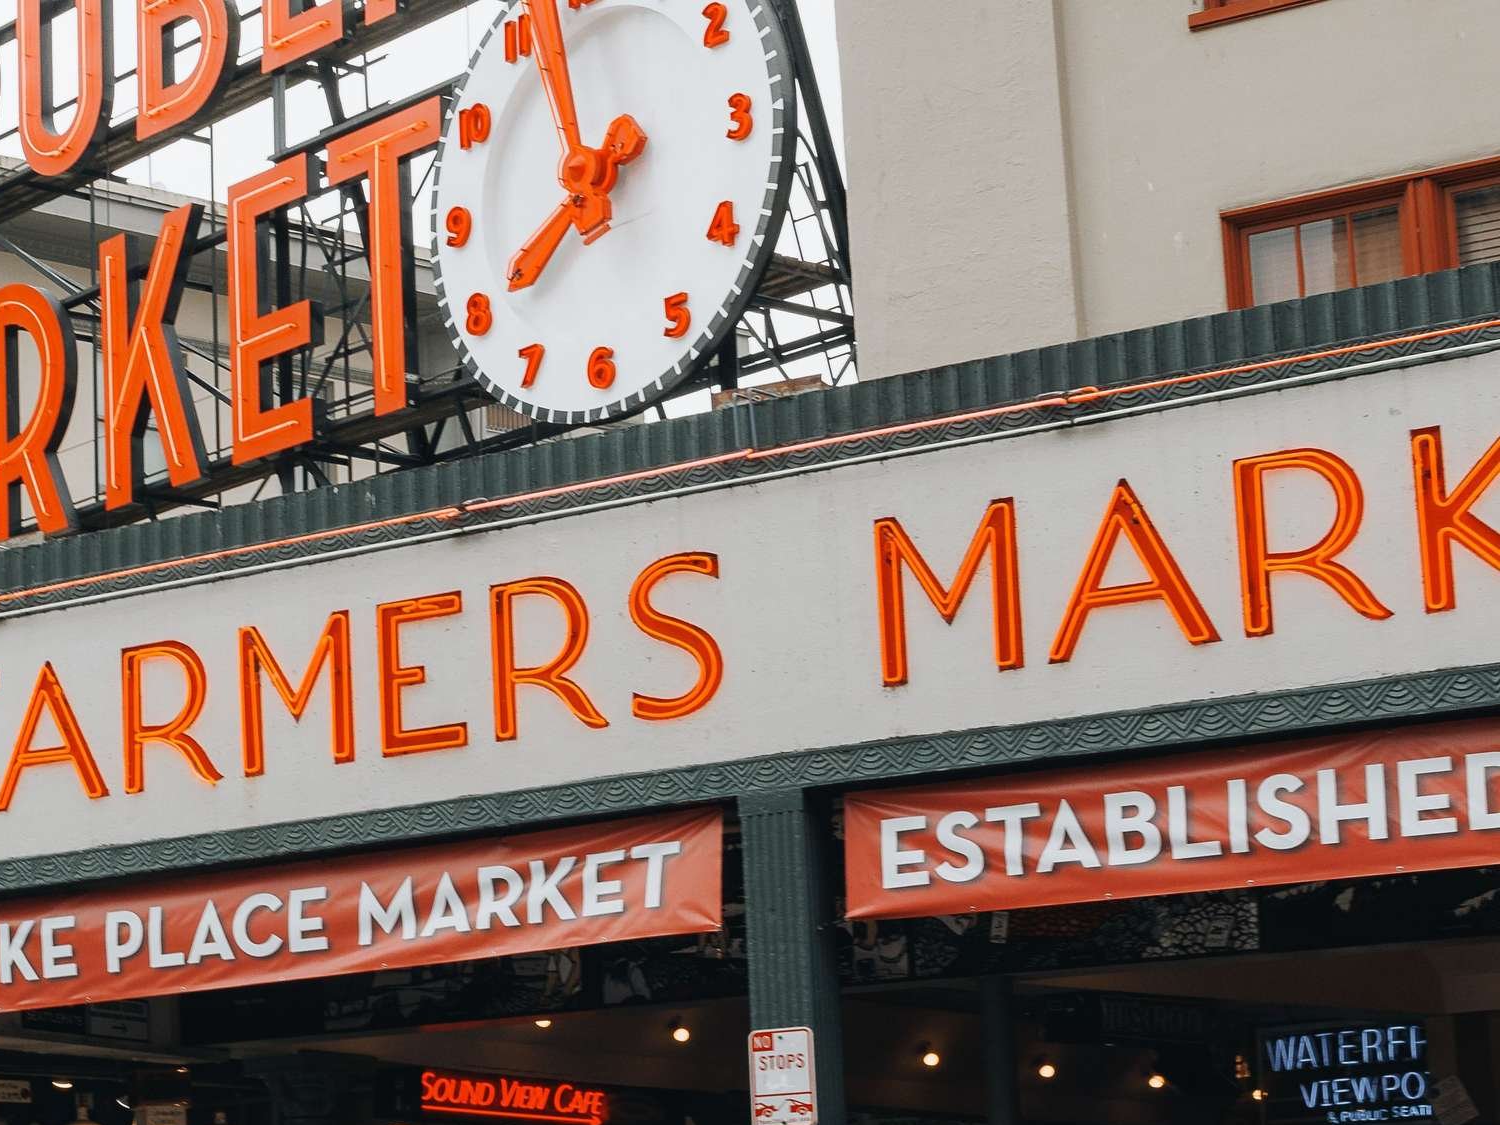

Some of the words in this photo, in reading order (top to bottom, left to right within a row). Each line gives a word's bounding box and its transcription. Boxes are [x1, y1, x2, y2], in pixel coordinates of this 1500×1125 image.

[702, 2, 729, 48] 2
[459, 102, 492, 150] 10
[726, 93, 753, 140] 3
[446, 206, 471, 248] 9
[706, 201, 739, 247] 4
[466, 292, 492, 336] 8
[663, 291, 691, 338] 5
[518, 343, 545, 388] 7
[587, 346, 616, 390] 6
[873, 425, 1500, 688] MARK
[105, 886, 329, 973] PLACE
[357, 841, 682, 946] MARKET
[754, 1035, 772, 1048] NO
[758, 1053, 805, 1071] STOPS
[421, 1071, 496, 1106] SOUND
[499, 1078, 551, 1110] VIEW
[1299, 1071, 1431, 1108] VIEWPO
